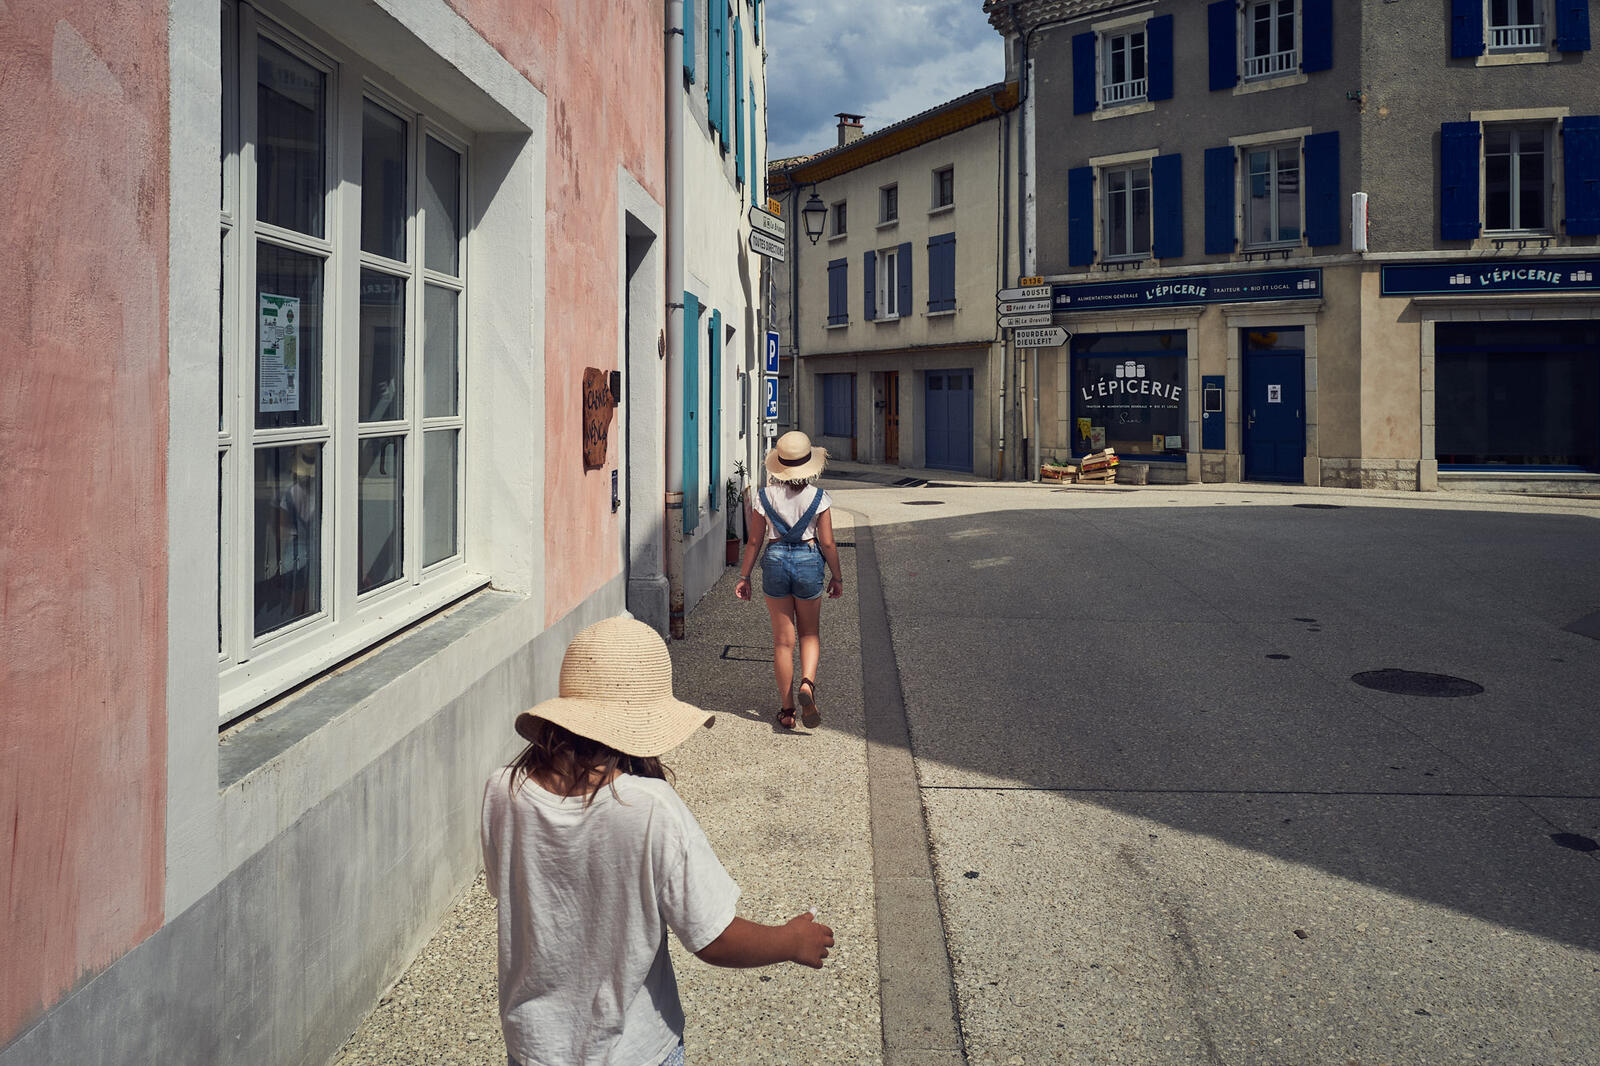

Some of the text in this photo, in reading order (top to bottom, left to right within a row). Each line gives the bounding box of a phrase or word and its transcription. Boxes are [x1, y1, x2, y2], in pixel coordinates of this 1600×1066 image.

[1029, 277, 1042, 285] 136
[1479, 268, 1562, 286] L'ÉPICERIE
[1021, 288, 1049, 297] AOUSTE
[1145, 284, 1207, 300] L'ÉPICERIE
[1017, 330, 1058, 338] BOURDEAUX
[1017, 338, 1052, 346] DIEULEFIT
[769, 340, 775, 365] P
[767, 382, 773, 407] P
[1082, 377, 1182, 401] L'ÉPICERIE
